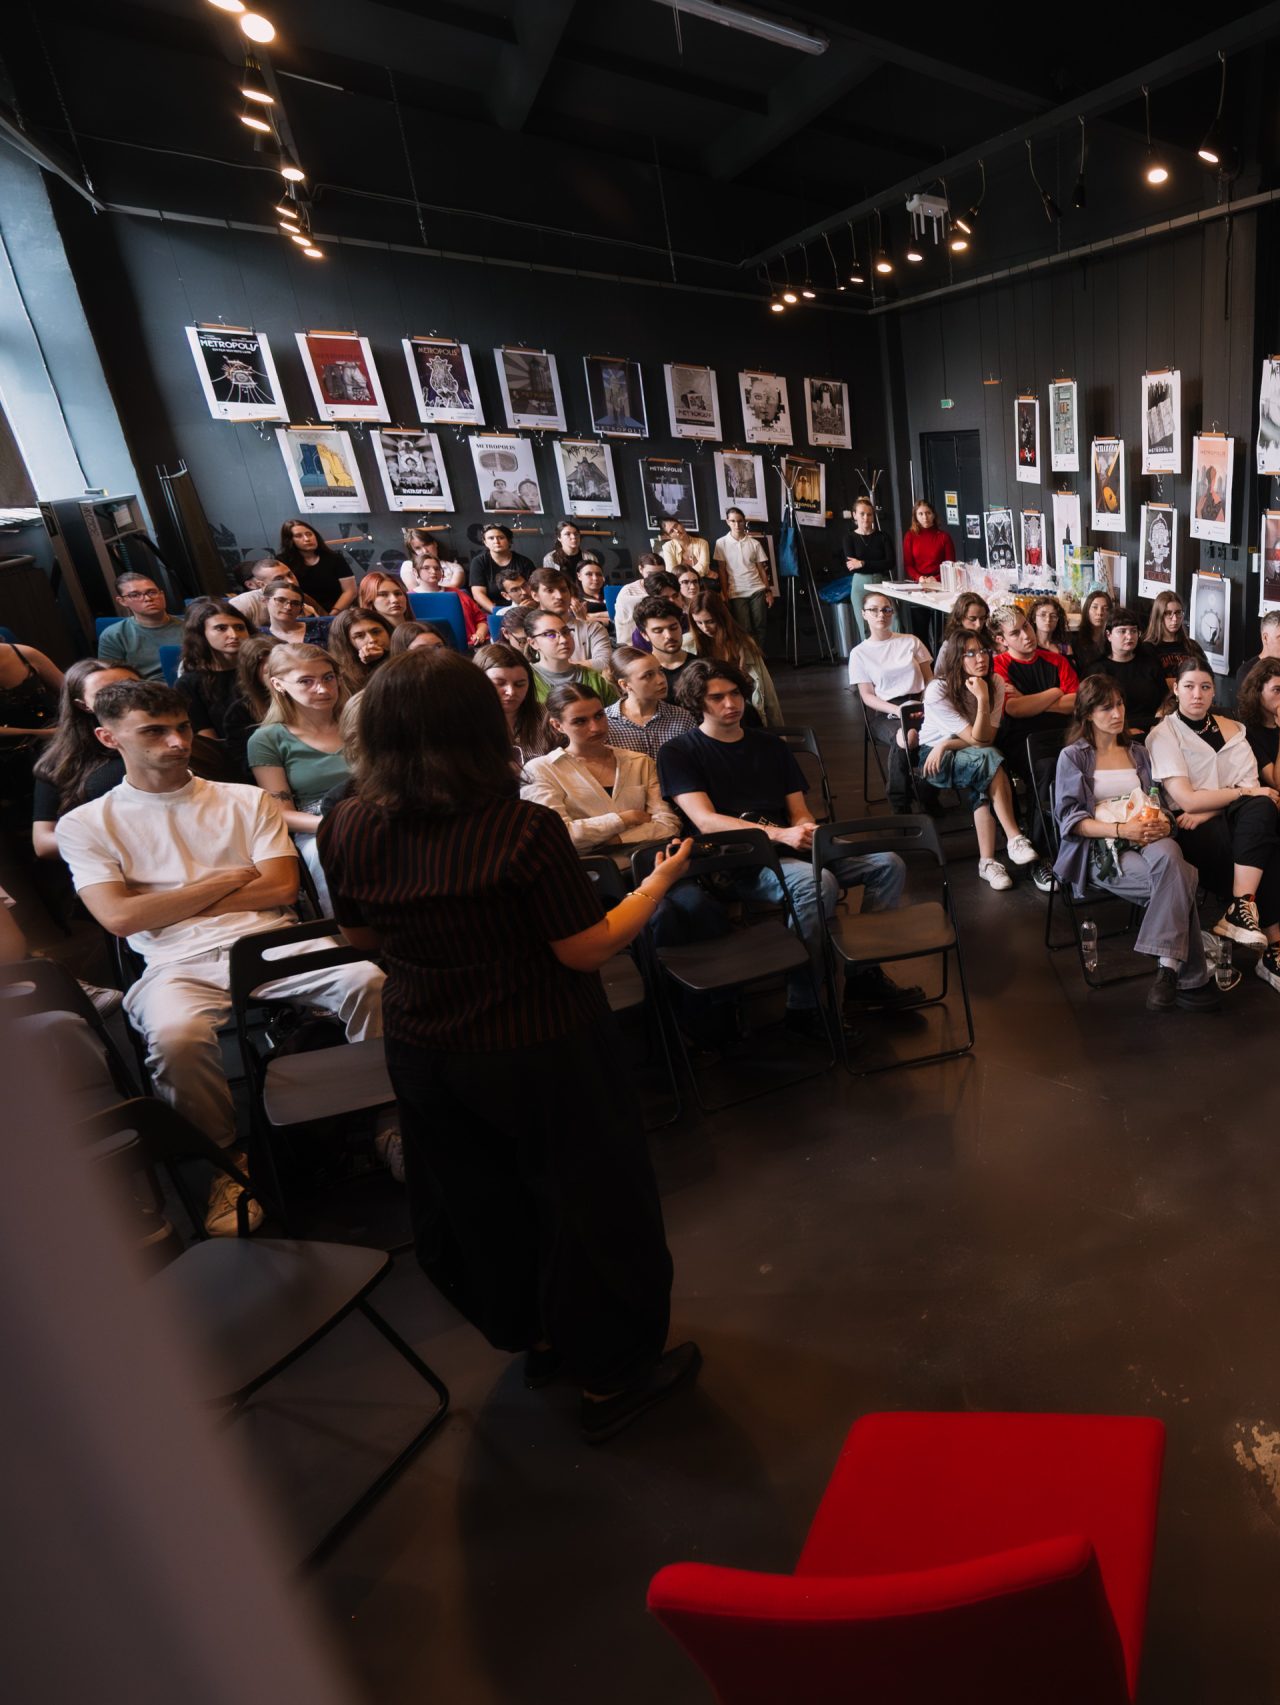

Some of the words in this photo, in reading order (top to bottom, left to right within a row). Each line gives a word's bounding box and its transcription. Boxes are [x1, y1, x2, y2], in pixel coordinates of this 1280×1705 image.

[200, 339, 259, 352] METROPOLIS
[418, 346, 458, 357] METROPOLIS
[476, 443, 516, 451] METROPOLIS
[649, 465, 684, 473] METROPOLIS
